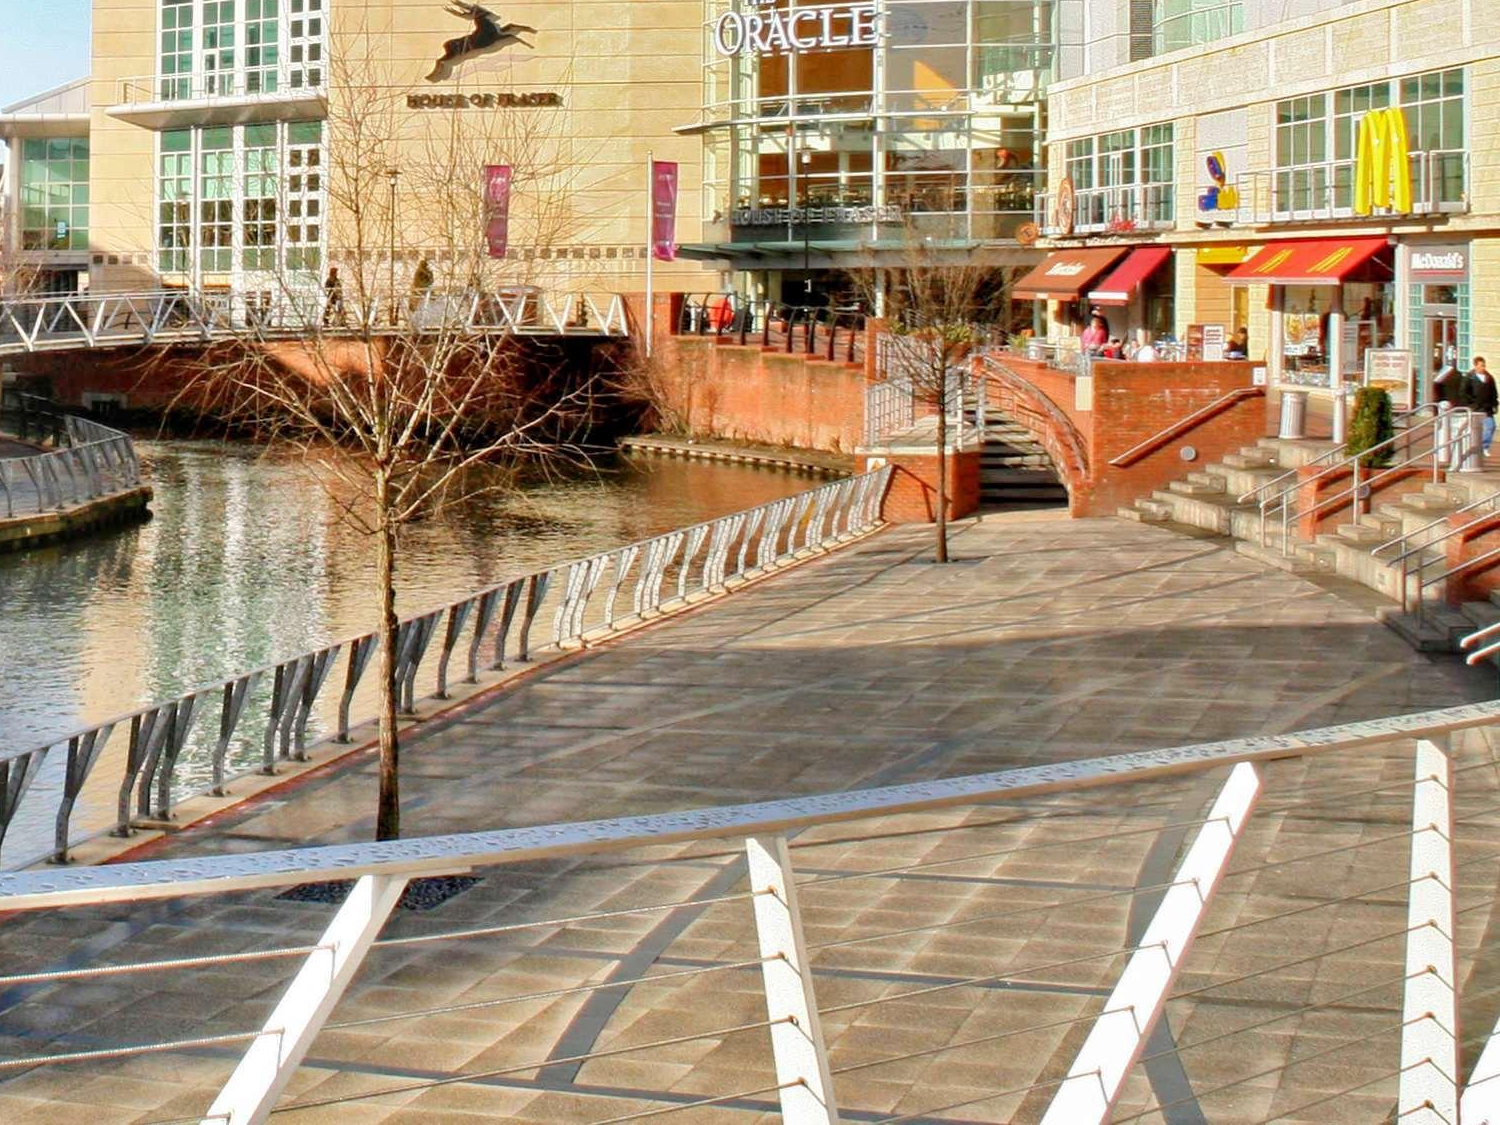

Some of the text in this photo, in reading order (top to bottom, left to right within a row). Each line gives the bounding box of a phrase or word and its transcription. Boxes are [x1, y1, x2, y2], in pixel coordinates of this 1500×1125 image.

[715, 7, 879, 56] ORACLE
[407, 93, 564, 109] HOUSE OF FRASER
[1411, 252, 1465, 269] McDonald's
